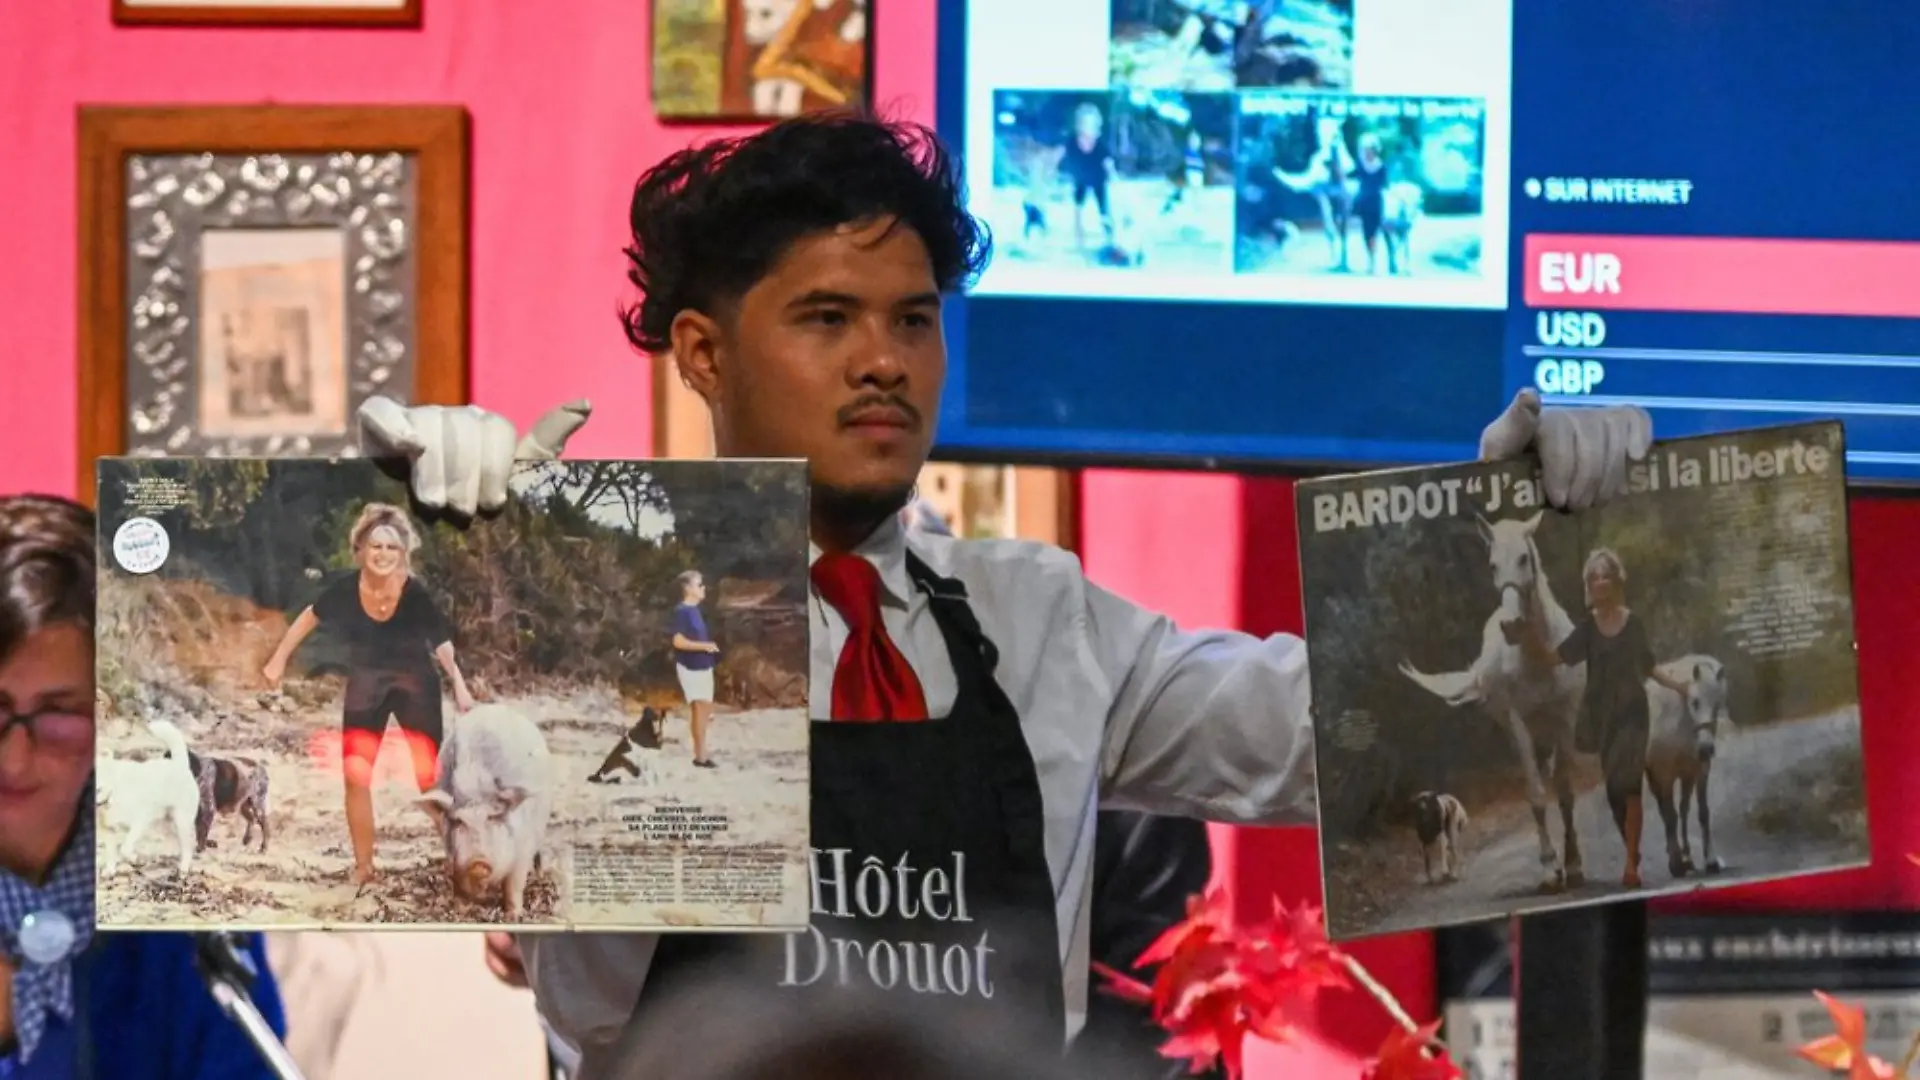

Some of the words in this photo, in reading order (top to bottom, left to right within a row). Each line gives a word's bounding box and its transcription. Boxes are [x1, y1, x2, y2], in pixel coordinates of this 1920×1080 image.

[1544, 176, 1588, 202] SUR
[1591, 178, 1694, 204] INTERNET
[1538, 251, 1622, 294] EUR
[1536, 311, 1606, 347] USD
[1534, 359, 1605, 395] GBP
[1313, 478, 1462, 533] BARDOT
[1668, 452, 1702, 489] la
[808, 848, 974, 921] Hôtel
[777, 922, 996, 999] Drouot
